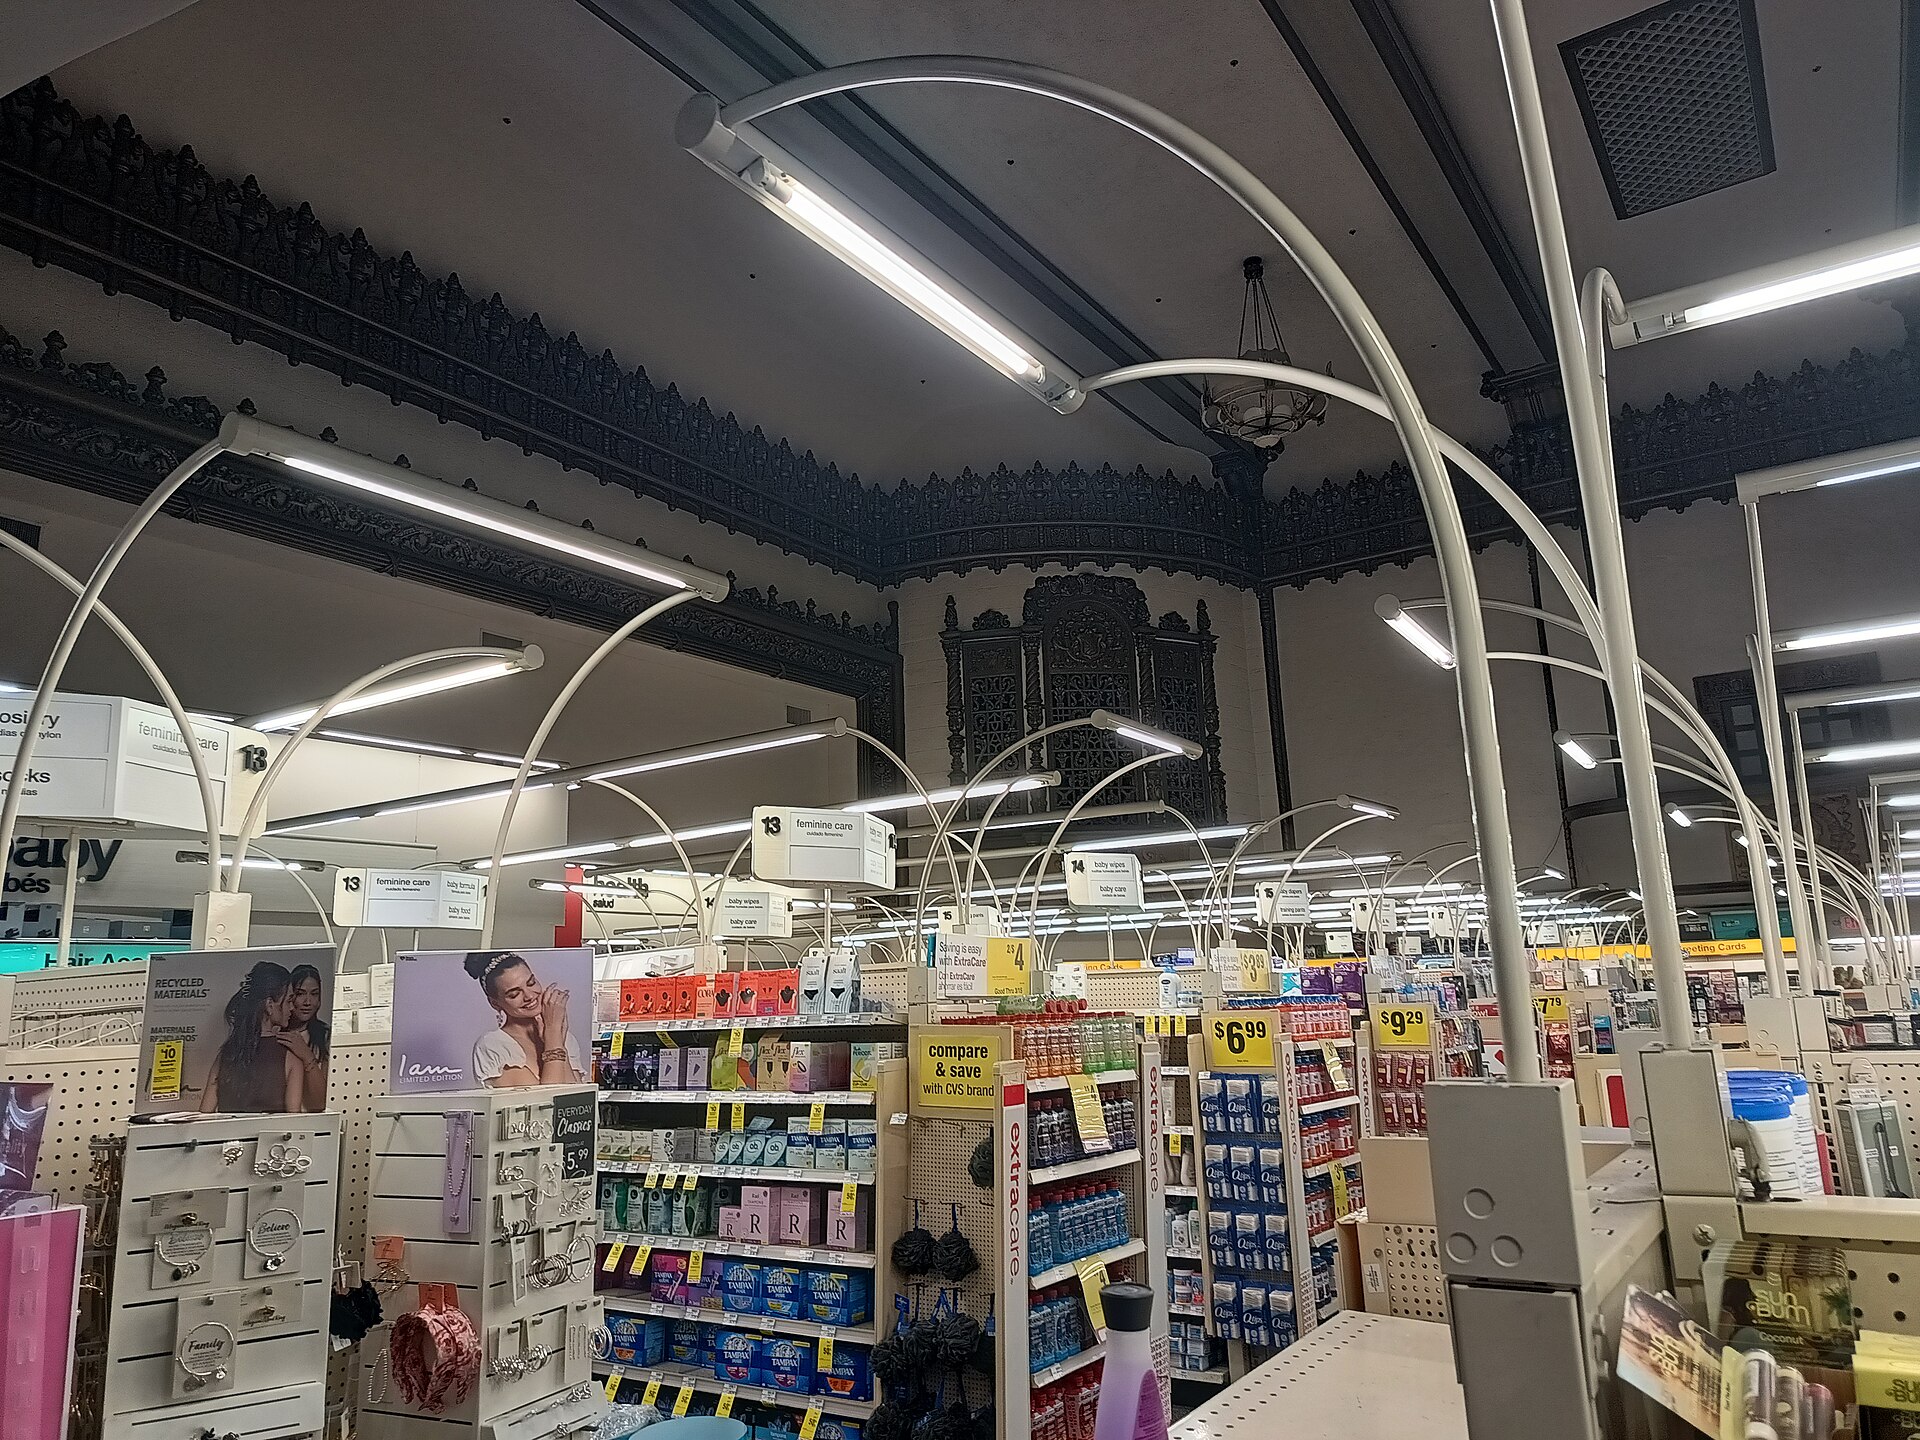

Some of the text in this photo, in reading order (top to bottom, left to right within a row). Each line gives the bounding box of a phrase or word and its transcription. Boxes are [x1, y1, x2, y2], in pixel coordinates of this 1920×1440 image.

[0, 710, 60, 729] osiry
[139, 721, 186, 742] feminin
[240, 744, 268, 773] 13
[0, 769, 51, 783] oks
[761, 816, 782, 836] 13
[796, 819, 853, 830] feminine care
[1094, 860, 1125, 869] baby wipes
[343, 876, 361, 891] 13
[376, 877, 431, 887] feminine care
[446, 880, 459, 889] baby
[1099, 885, 1113, 893] baby
[728, 898, 742, 906] baby
[448, 906, 460, 915] baby
[939, 941, 983, 956] Saving is easy
[1718, 942, 1747, 952] Cards
[954, 956, 987, 967] ExtraCare
[155, 978, 204, 988] RECYCLED
[153, 989, 208, 1000] MATERIALS
[928, 1043, 989, 1061] compare
[935, 1063, 982, 1078] & save
[399, 1074, 463, 1084] LIMITED EDITION
[923, 1082, 994, 1097] with CVS brand
[557, 1104, 593, 1118] EVERYDAY
[557, 1117, 592, 1137] Classics
[1149, 1066, 1159, 1193] extracare
[563, 1148, 589, 1170] 5.99
[1009, 1122, 1021, 1277] extracare
[728, 1281, 752, 1290] TAMPAX
[767, 1285, 792, 1294] TAMPAX
[813, 1291, 840, 1300] TAMPAX
[613, 1335, 636, 1343] TAMPAX
[674, 1333, 697, 1342] TAMPAX
[1759, 1331, 1805, 1345] Coconut
[188, 1338, 226, 1353] Family
[724, 1351, 749, 1359] TAMPAX
[771, 1358, 798, 1366] TAMPAX
